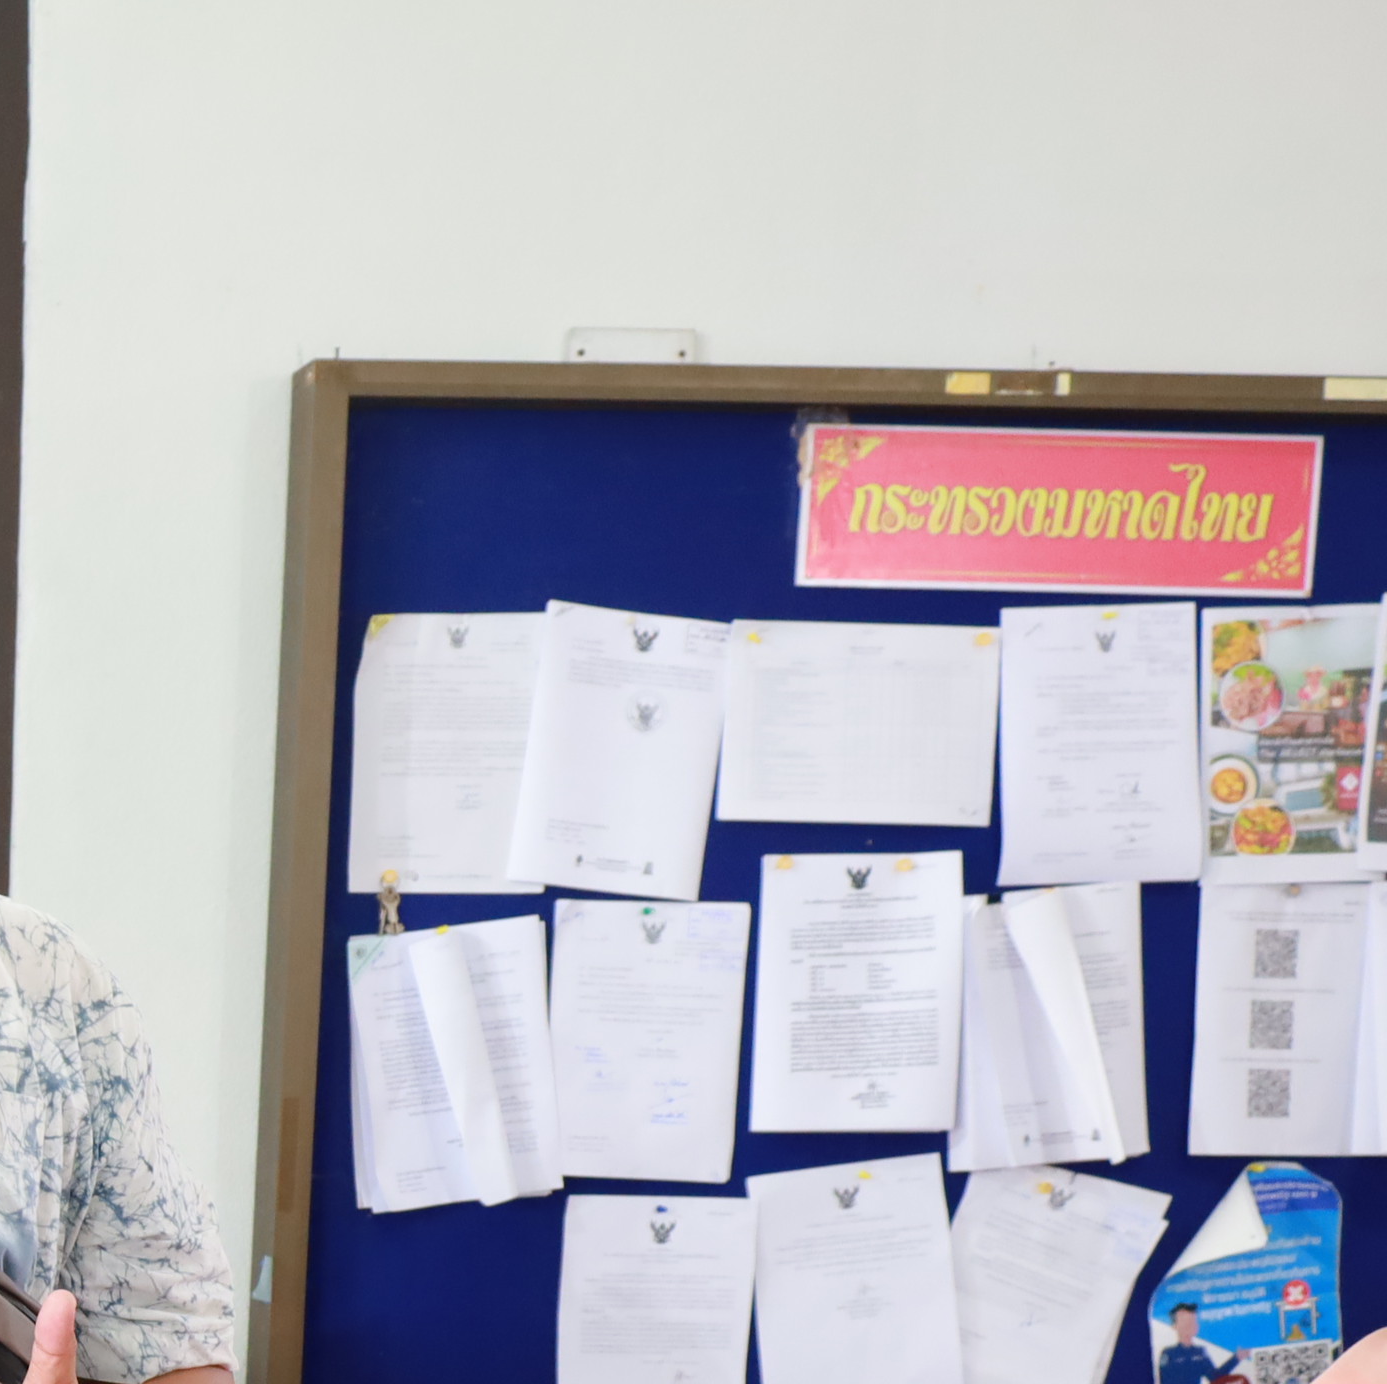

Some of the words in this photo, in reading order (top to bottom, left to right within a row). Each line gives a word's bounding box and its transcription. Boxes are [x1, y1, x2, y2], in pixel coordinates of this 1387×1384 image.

[847, 462, 1275, 543] กระทรวงมหาดไทย
